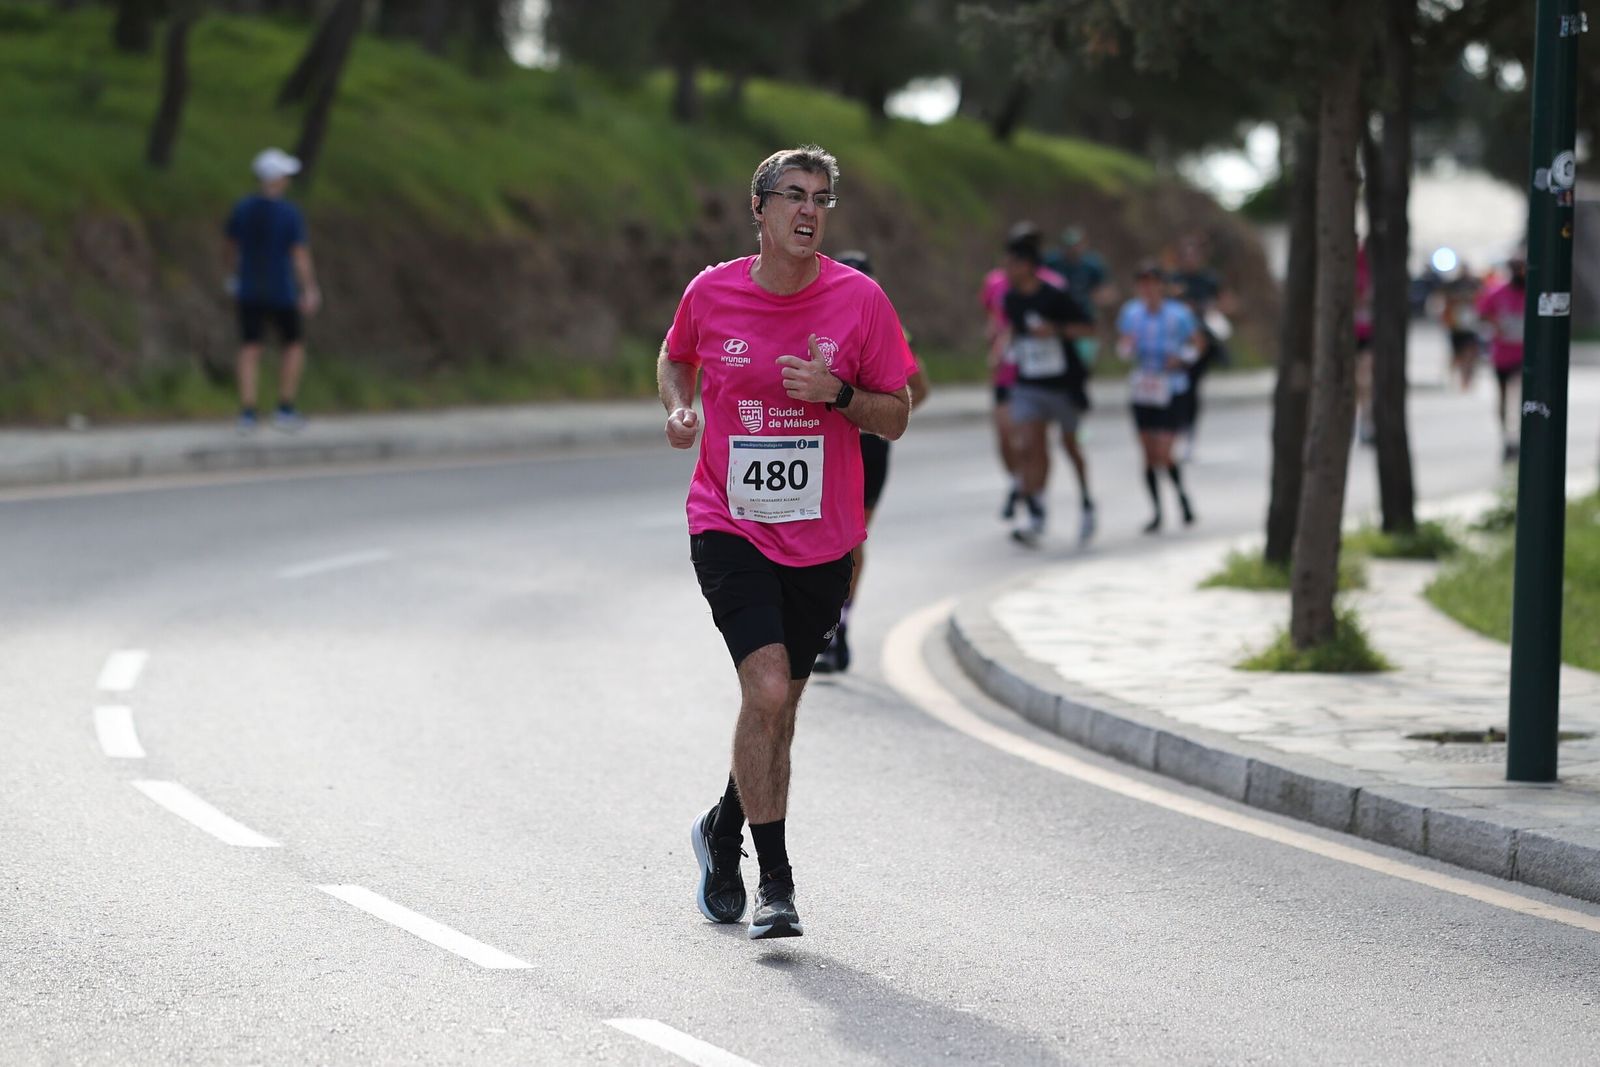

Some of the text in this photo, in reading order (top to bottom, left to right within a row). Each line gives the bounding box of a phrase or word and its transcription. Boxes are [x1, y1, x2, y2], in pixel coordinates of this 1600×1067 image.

[720, 356, 751, 364] HYUNDAI
[768, 407, 805, 417] Ciudad
[768, 418, 820, 429] de Málaga
[742, 459, 809, 492] 480
